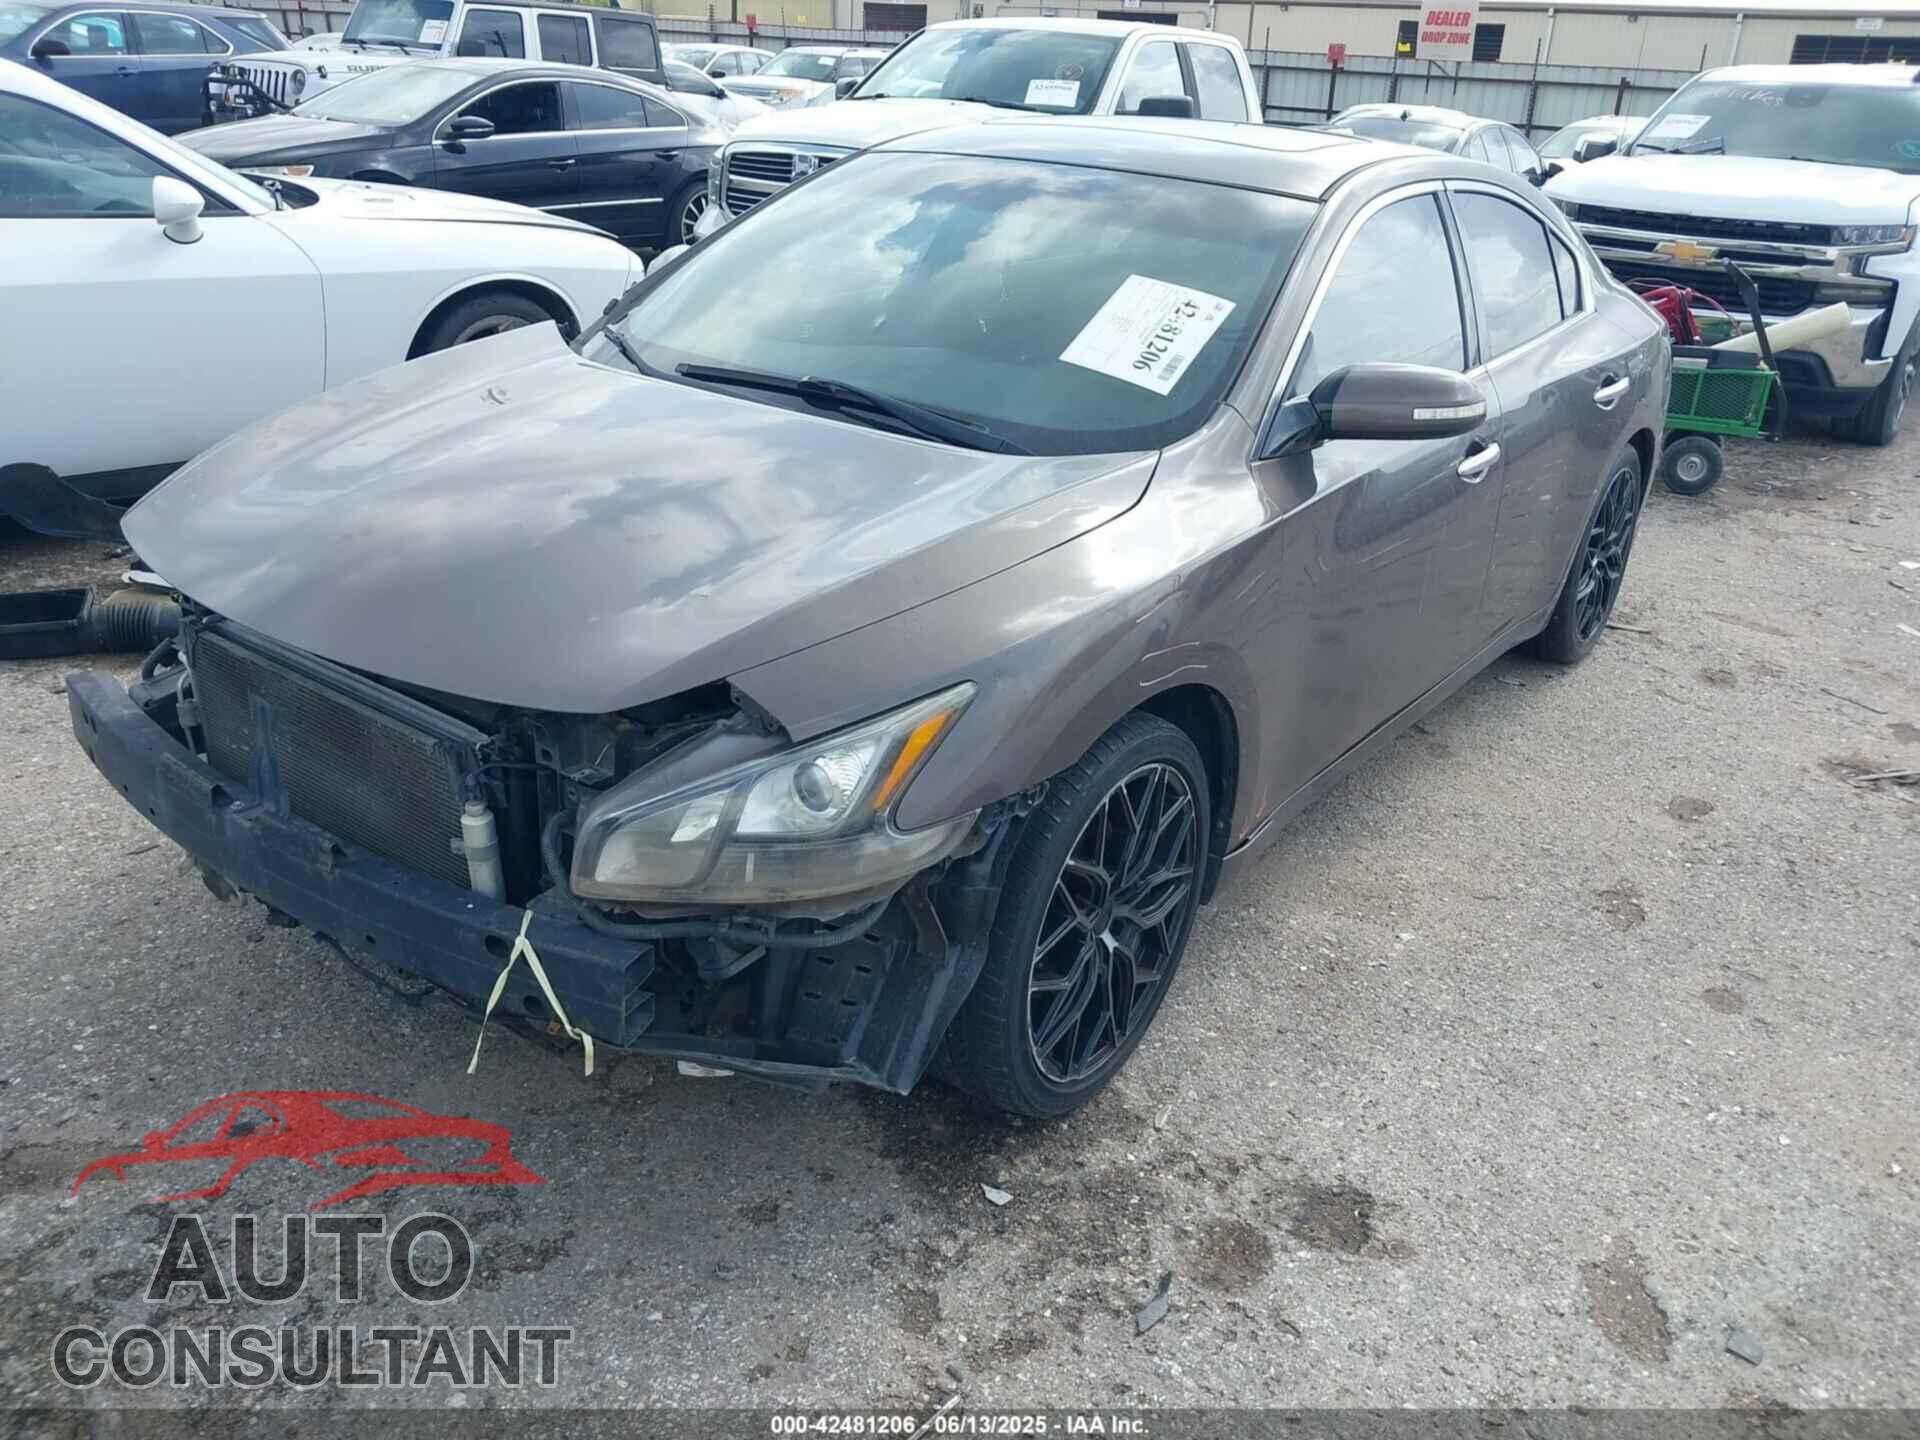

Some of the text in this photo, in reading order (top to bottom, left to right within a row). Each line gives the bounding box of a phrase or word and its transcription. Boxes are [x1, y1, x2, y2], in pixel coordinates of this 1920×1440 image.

[1425, 10, 1471, 27] DEALER
[1421, 31, 1471, 45] DROP ZONE
